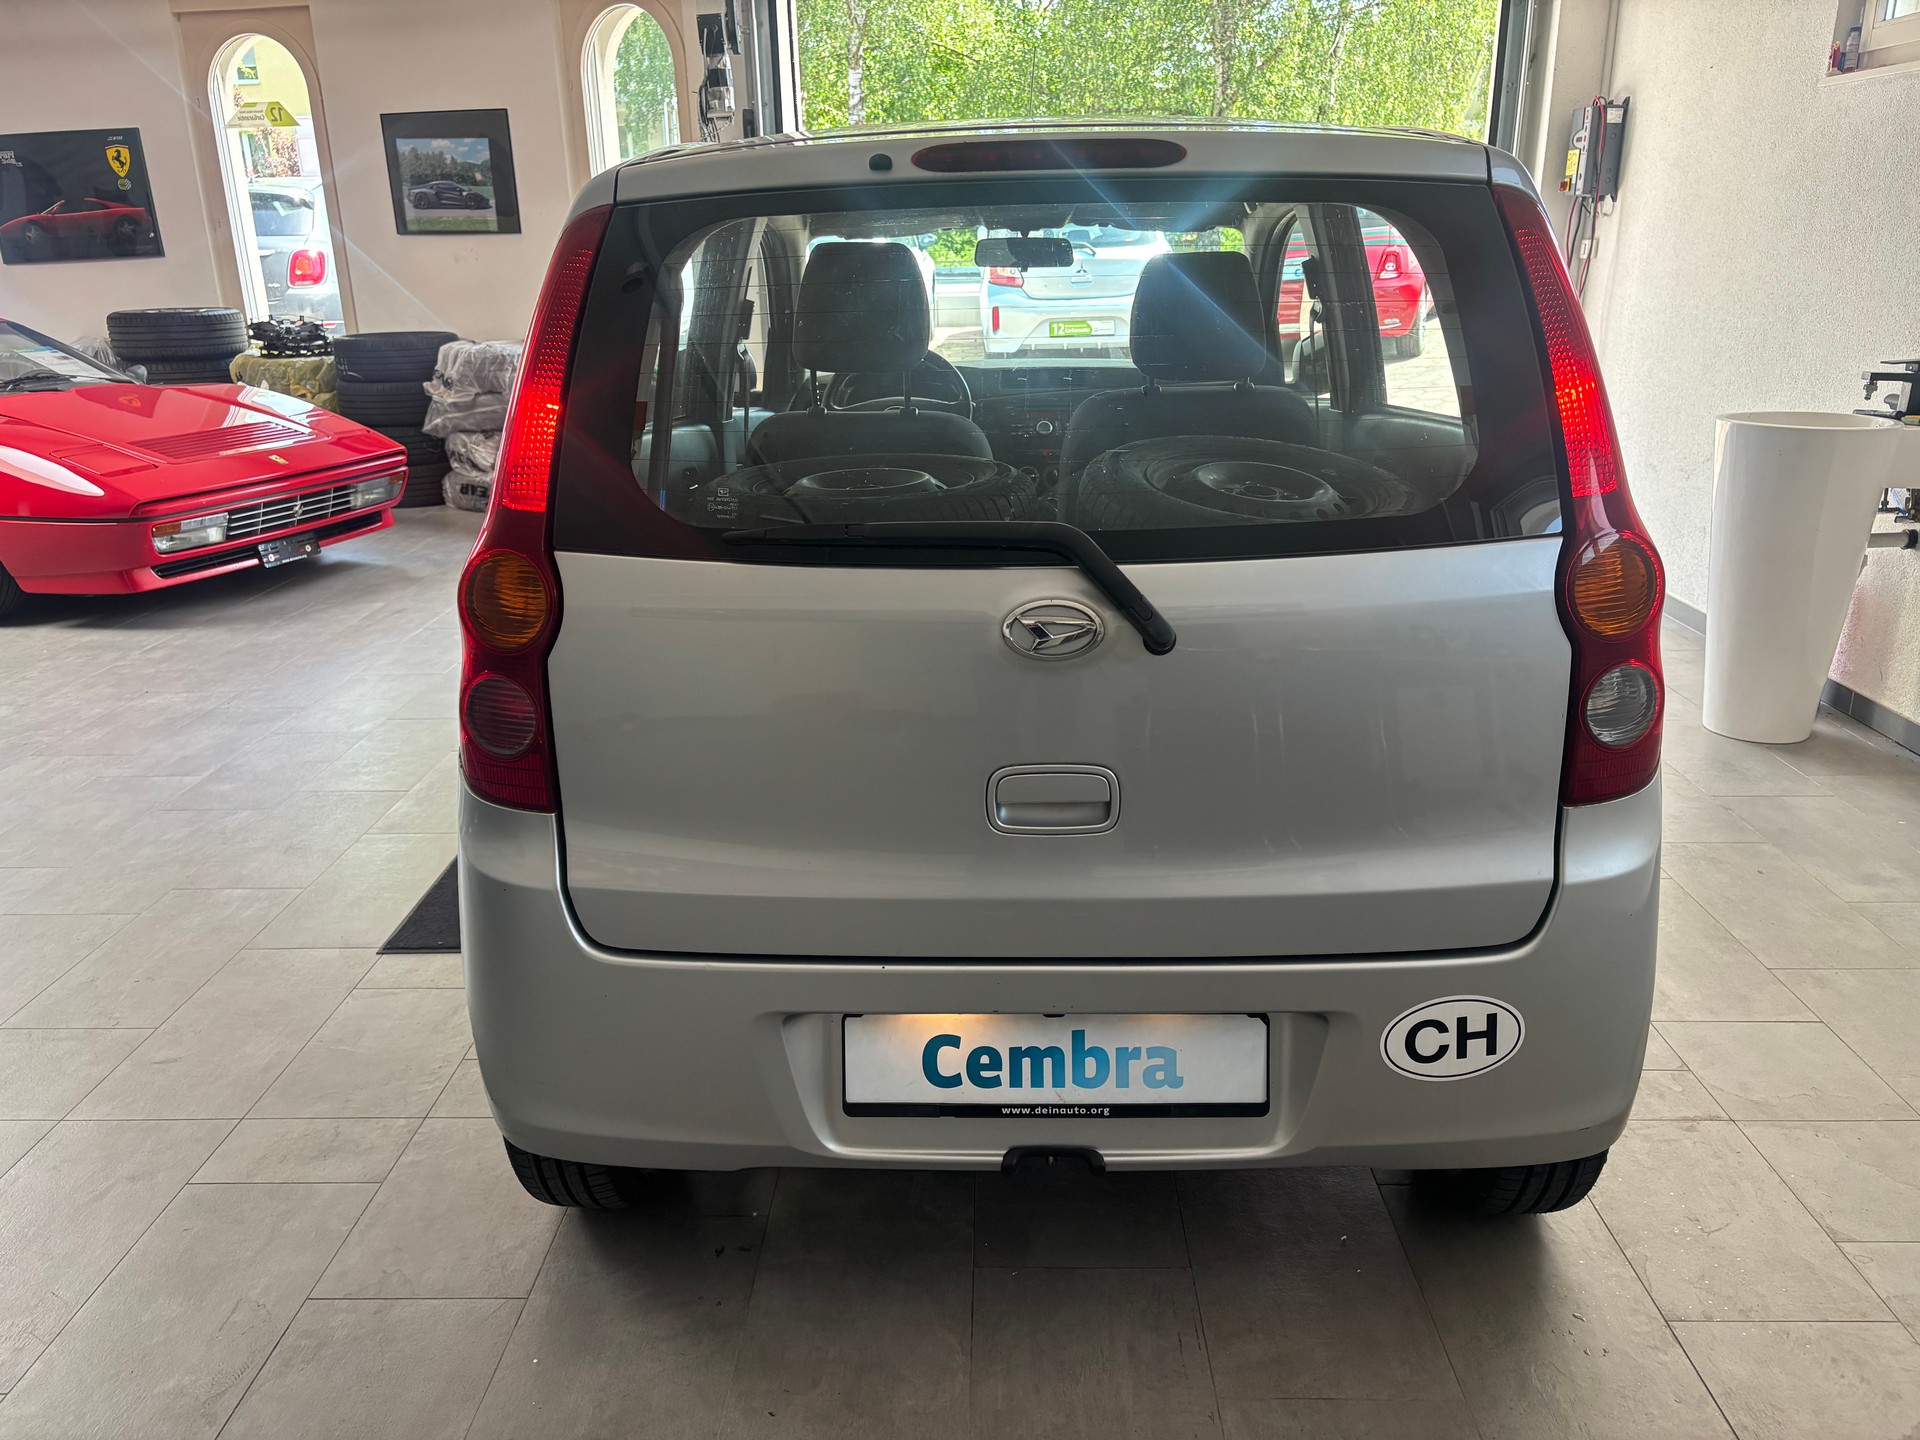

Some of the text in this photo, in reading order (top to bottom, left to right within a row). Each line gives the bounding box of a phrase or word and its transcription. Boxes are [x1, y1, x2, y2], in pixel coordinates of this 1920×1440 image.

[1052, 323, 1065, 336] 12
[1405, 1012, 1498, 1064] CH
[922, 1029, 1184, 1089] Cembra
[1001, 1106, 1110, 1116] www.deinauto.org
